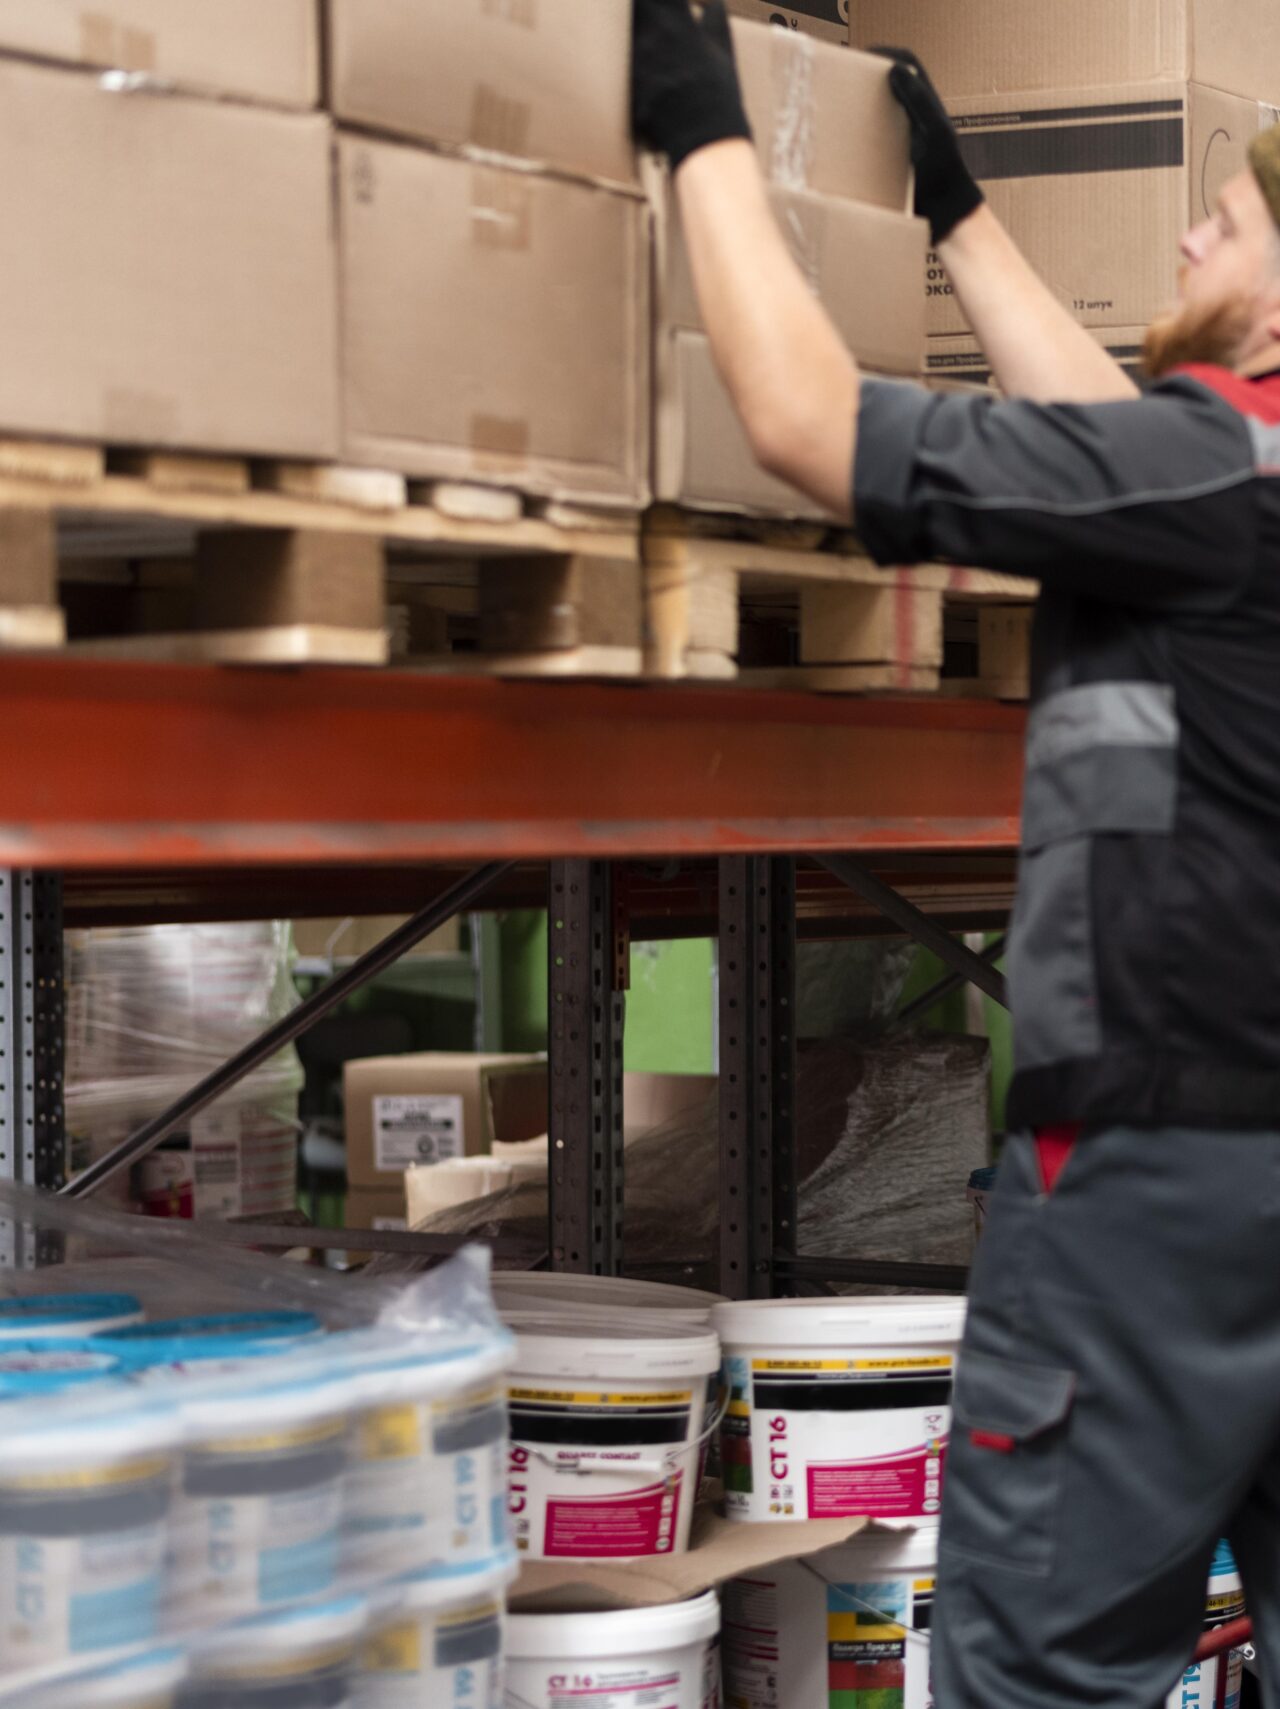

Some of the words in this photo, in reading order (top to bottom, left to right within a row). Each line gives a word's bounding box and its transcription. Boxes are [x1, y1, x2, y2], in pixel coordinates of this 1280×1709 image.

[1073, 300, 1085, 309] 12
[1087, 300, 1113, 311] штук
[769, 1415, 788, 1443] 16
[509, 1447, 529, 1473] 16
[769, 1447, 789, 1480] CT
[509, 1484, 527, 1514] CT
[548, 1675, 567, 1688] CT
[574, 1673, 593, 1687] 16
